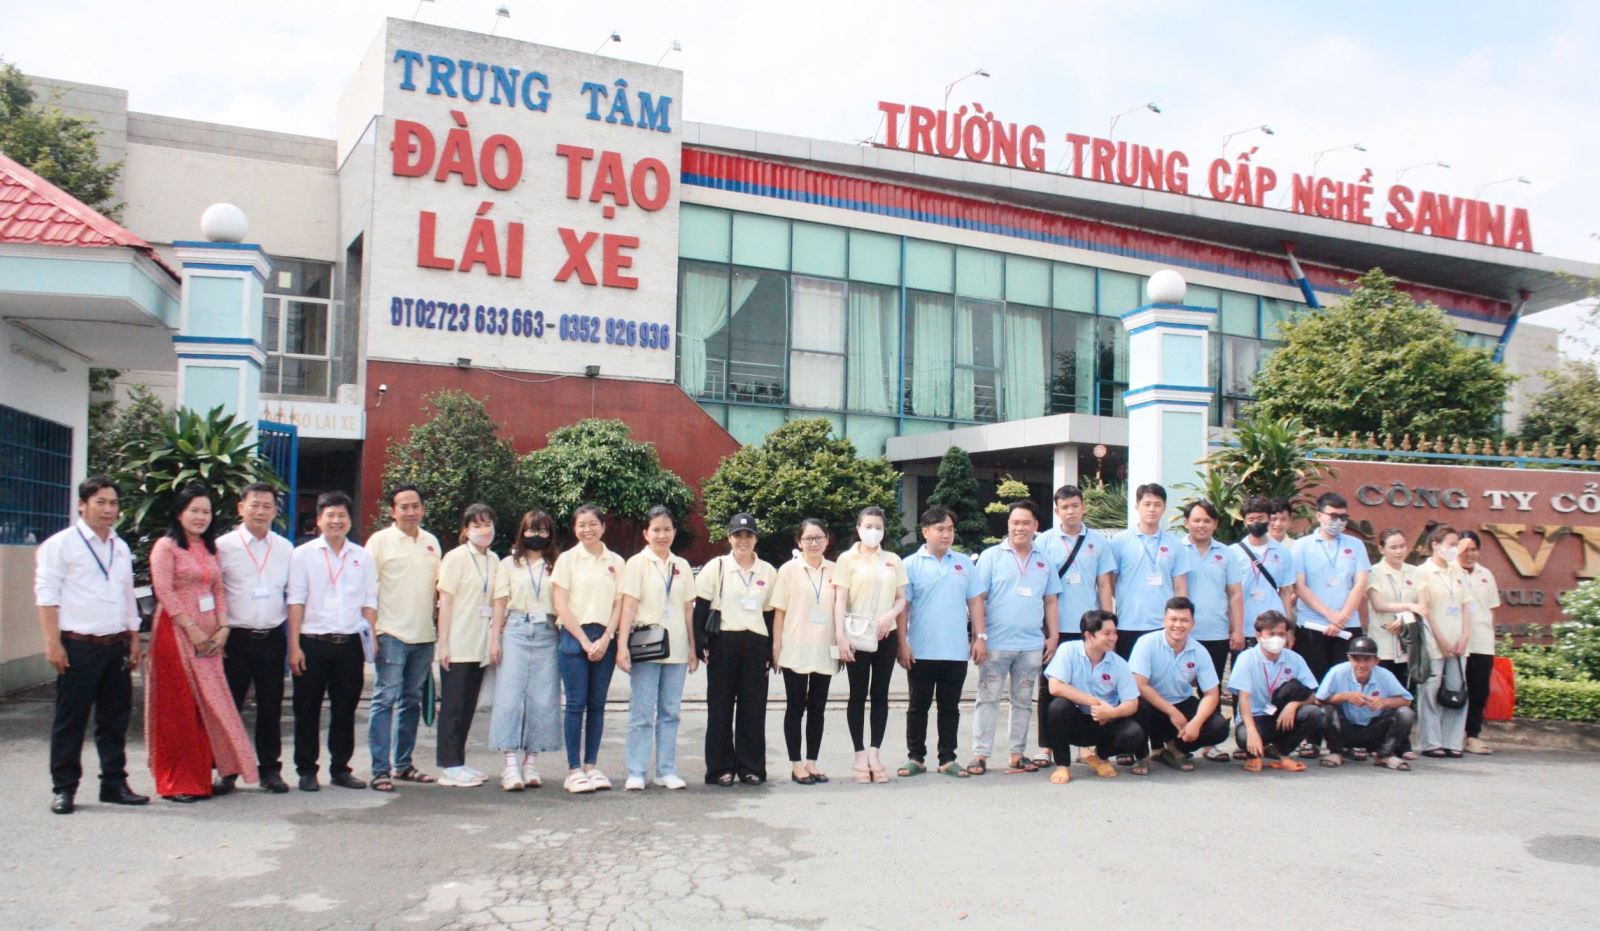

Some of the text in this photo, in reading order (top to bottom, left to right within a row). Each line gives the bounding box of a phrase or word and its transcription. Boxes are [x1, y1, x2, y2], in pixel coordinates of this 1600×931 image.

[393, 49, 673, 133] TRUNG TÂM
[390, 110, 671, 219] ĐÀO TẠO
[878, 101, 1046, 172] TRƯỜNG
[1065, 133, 1190, 194] TRUNG
[1208, 146, 1277, 208] CẤP
[1386, 185, 1534, 252] SAVINA
[417, 201, 640, 289] LÁI XE
[475, 305, 509, 336] 633
[605, 318, 637, 347] 926
[639, 322, 670, 351] 936
[1355, 480, 1600, 513] CÔNG TY CỔ
